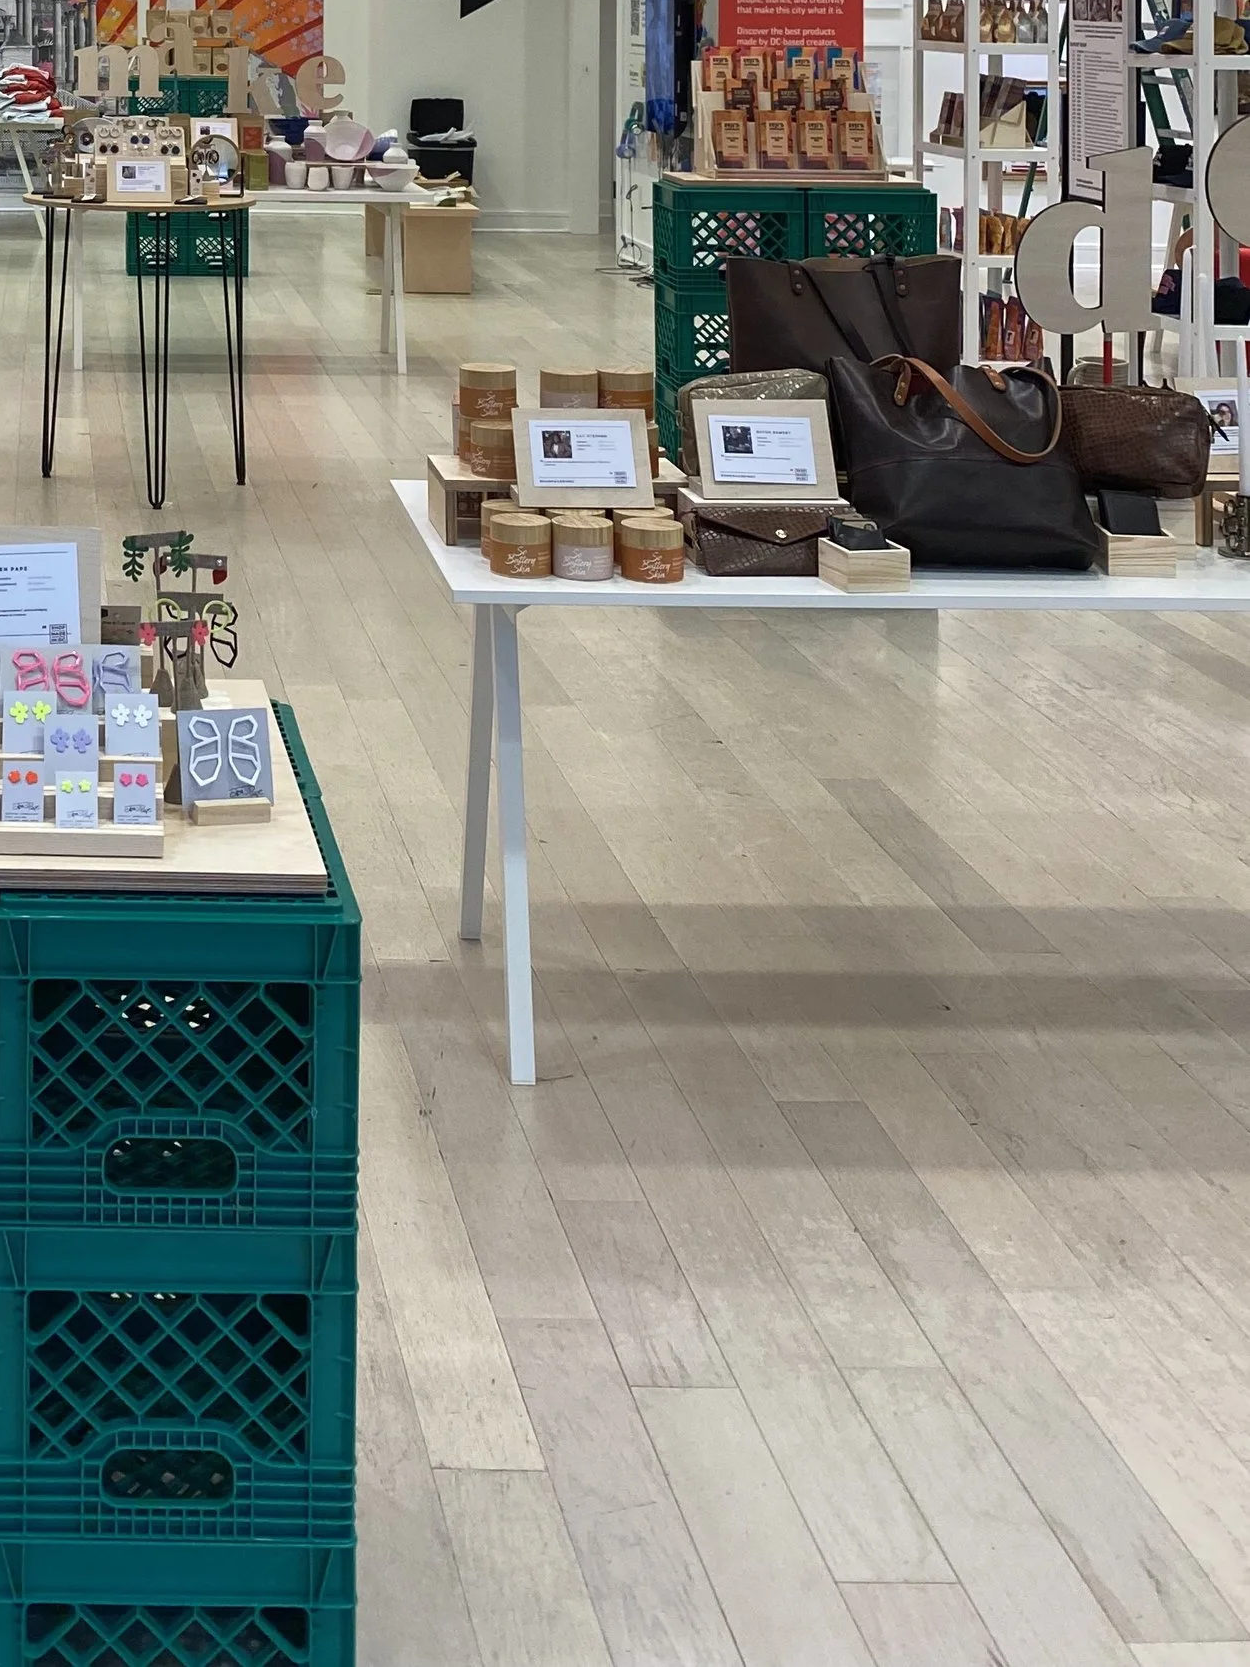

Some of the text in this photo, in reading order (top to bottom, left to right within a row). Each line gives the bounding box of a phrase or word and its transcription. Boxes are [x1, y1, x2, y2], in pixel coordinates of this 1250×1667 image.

[737, 6, 844, 15] that make this city what it is.
[737, 27, 836, 36] Discover the best products
[758, 38, 768, 46] by
[73, 23, 346, 117] make
[510, 564, 531, 574] Skin
[646, 569, 666, 580] Skin
